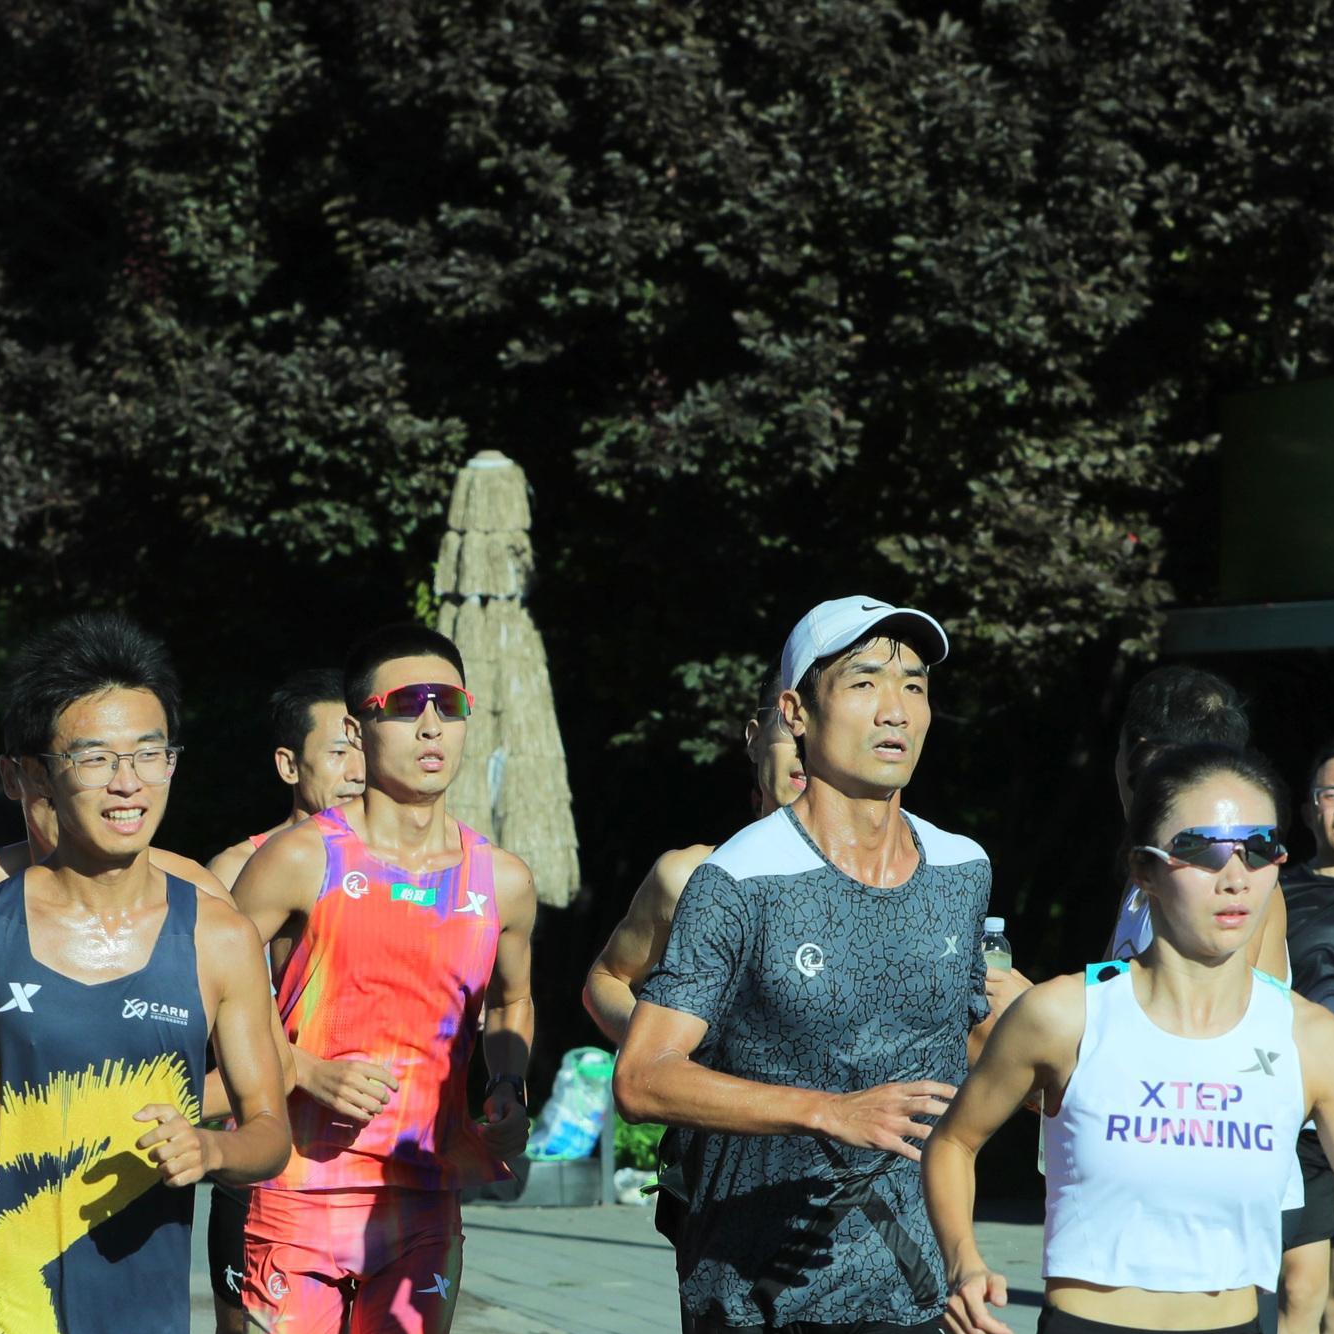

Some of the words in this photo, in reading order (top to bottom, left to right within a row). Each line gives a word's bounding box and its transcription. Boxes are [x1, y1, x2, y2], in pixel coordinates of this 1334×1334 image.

[149, 1002, 189, 1019] CARM
[1140, 1080, 1244, 1112] XTEP
[1105, 1114, 1274, 1152] RUNNING
